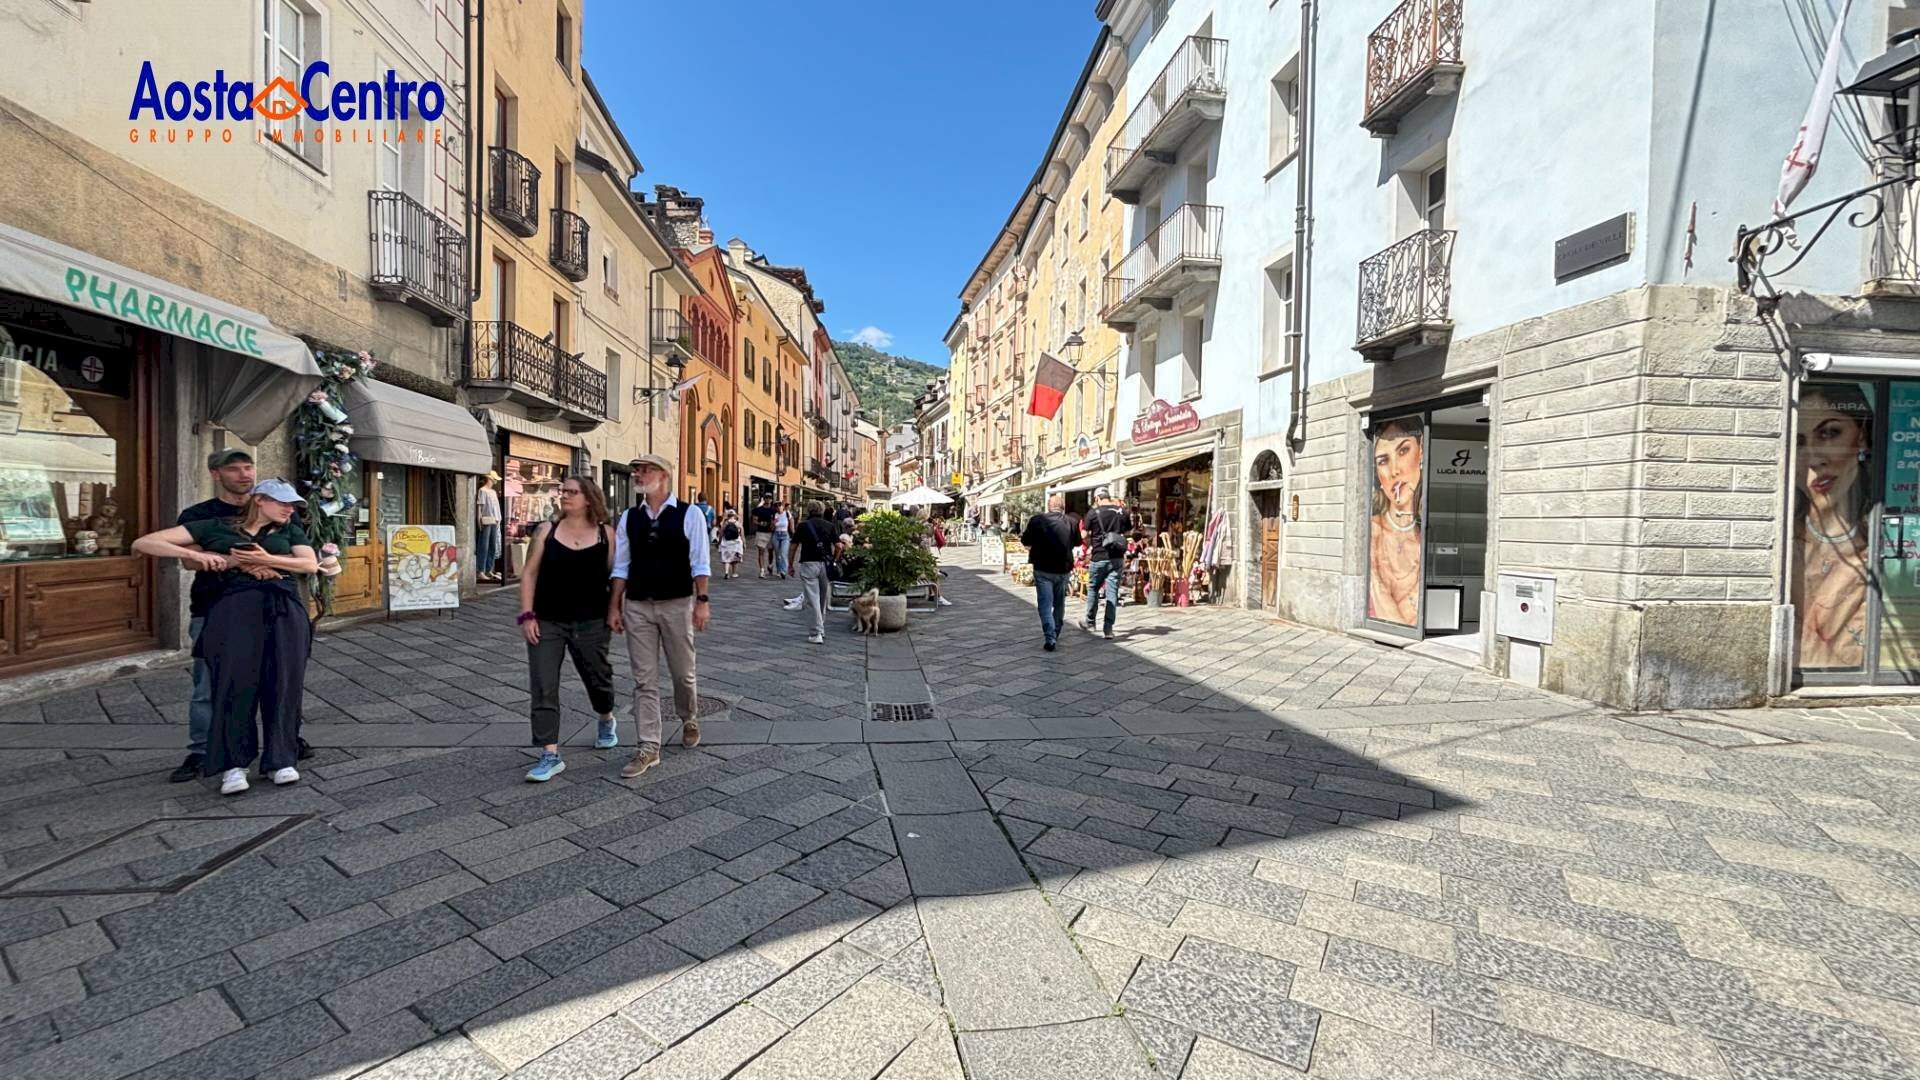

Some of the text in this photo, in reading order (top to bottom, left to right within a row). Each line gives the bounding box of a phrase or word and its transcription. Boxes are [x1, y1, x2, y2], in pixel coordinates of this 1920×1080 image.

[65, 267, 264, 356] PHARMACIE
[1436, 467, 1487, 476] LUCA BARRA
